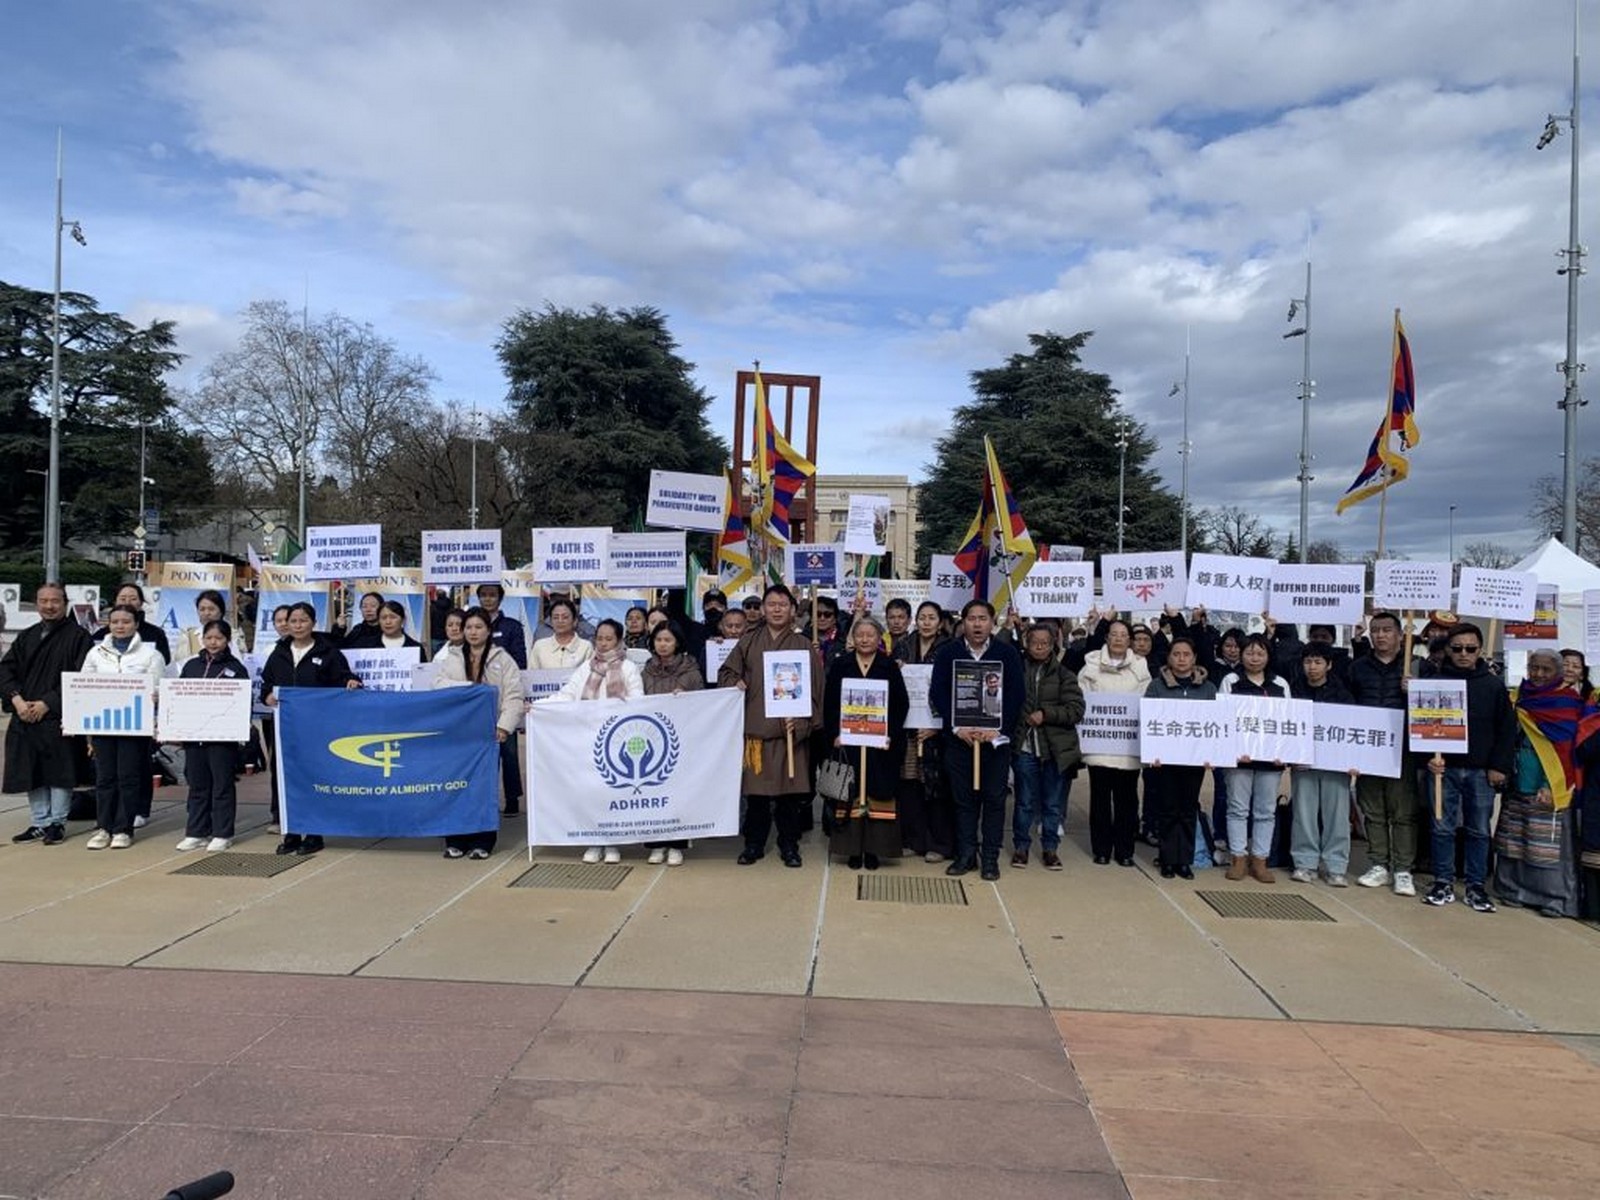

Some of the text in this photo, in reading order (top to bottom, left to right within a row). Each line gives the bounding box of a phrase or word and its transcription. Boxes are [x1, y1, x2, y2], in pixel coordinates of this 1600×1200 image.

[659, 489, 716, 502] SOLIDARITY WITH
[652, 499, 721, 514] PERSECUTED GROUPS
[310, 535, 377, 547] KEIN KULTURELLER
[427, 542, 495, 552] PROTEST AGAINST
[551, 542, 595, 554] FAITH IS
[436, 554, 487, 563] CCP'S HUMAN
[610, 551, 633, 559] DEFEND
[657, 550, 683, 558] RIGHTS!
[431, 565, 493, 574] RIGHTS ABUSES!
[546, 558, 601, 571] NO CRIME!
[616, 560, 678, 568] STOP PERSECUTION!
[170, 571, 225, 582] POINT 10
[1113, 564, 1175, 581] 向迫害说
[271, 573, 302, 584] POIN
[410, 577, 418, 587] 8
[841, 580, 876, 588] HUAN
[936, 573, 975, 589] 还我
[1023, 575, 1085, 588] STOP CCP'S
[1273, 583, 1361, 594] DEFEND RELIGIOUS
[1030, 592, 1078, 604] TYRANNY
[1292, 596, 1340, 607] FREEDOM!
[532, 682, 560, 692] UNITED
[1091, 705, 1127, 715] PROTEST
[1106, 718, 1140, 727] RELIGIO
[1081, 729, 1138, 740] PERSECUTION
[313, 780, 468, 795] THE CHURCH OF ALMIGHTY GOD
[609, 796, 670, 811] ADHRRF
